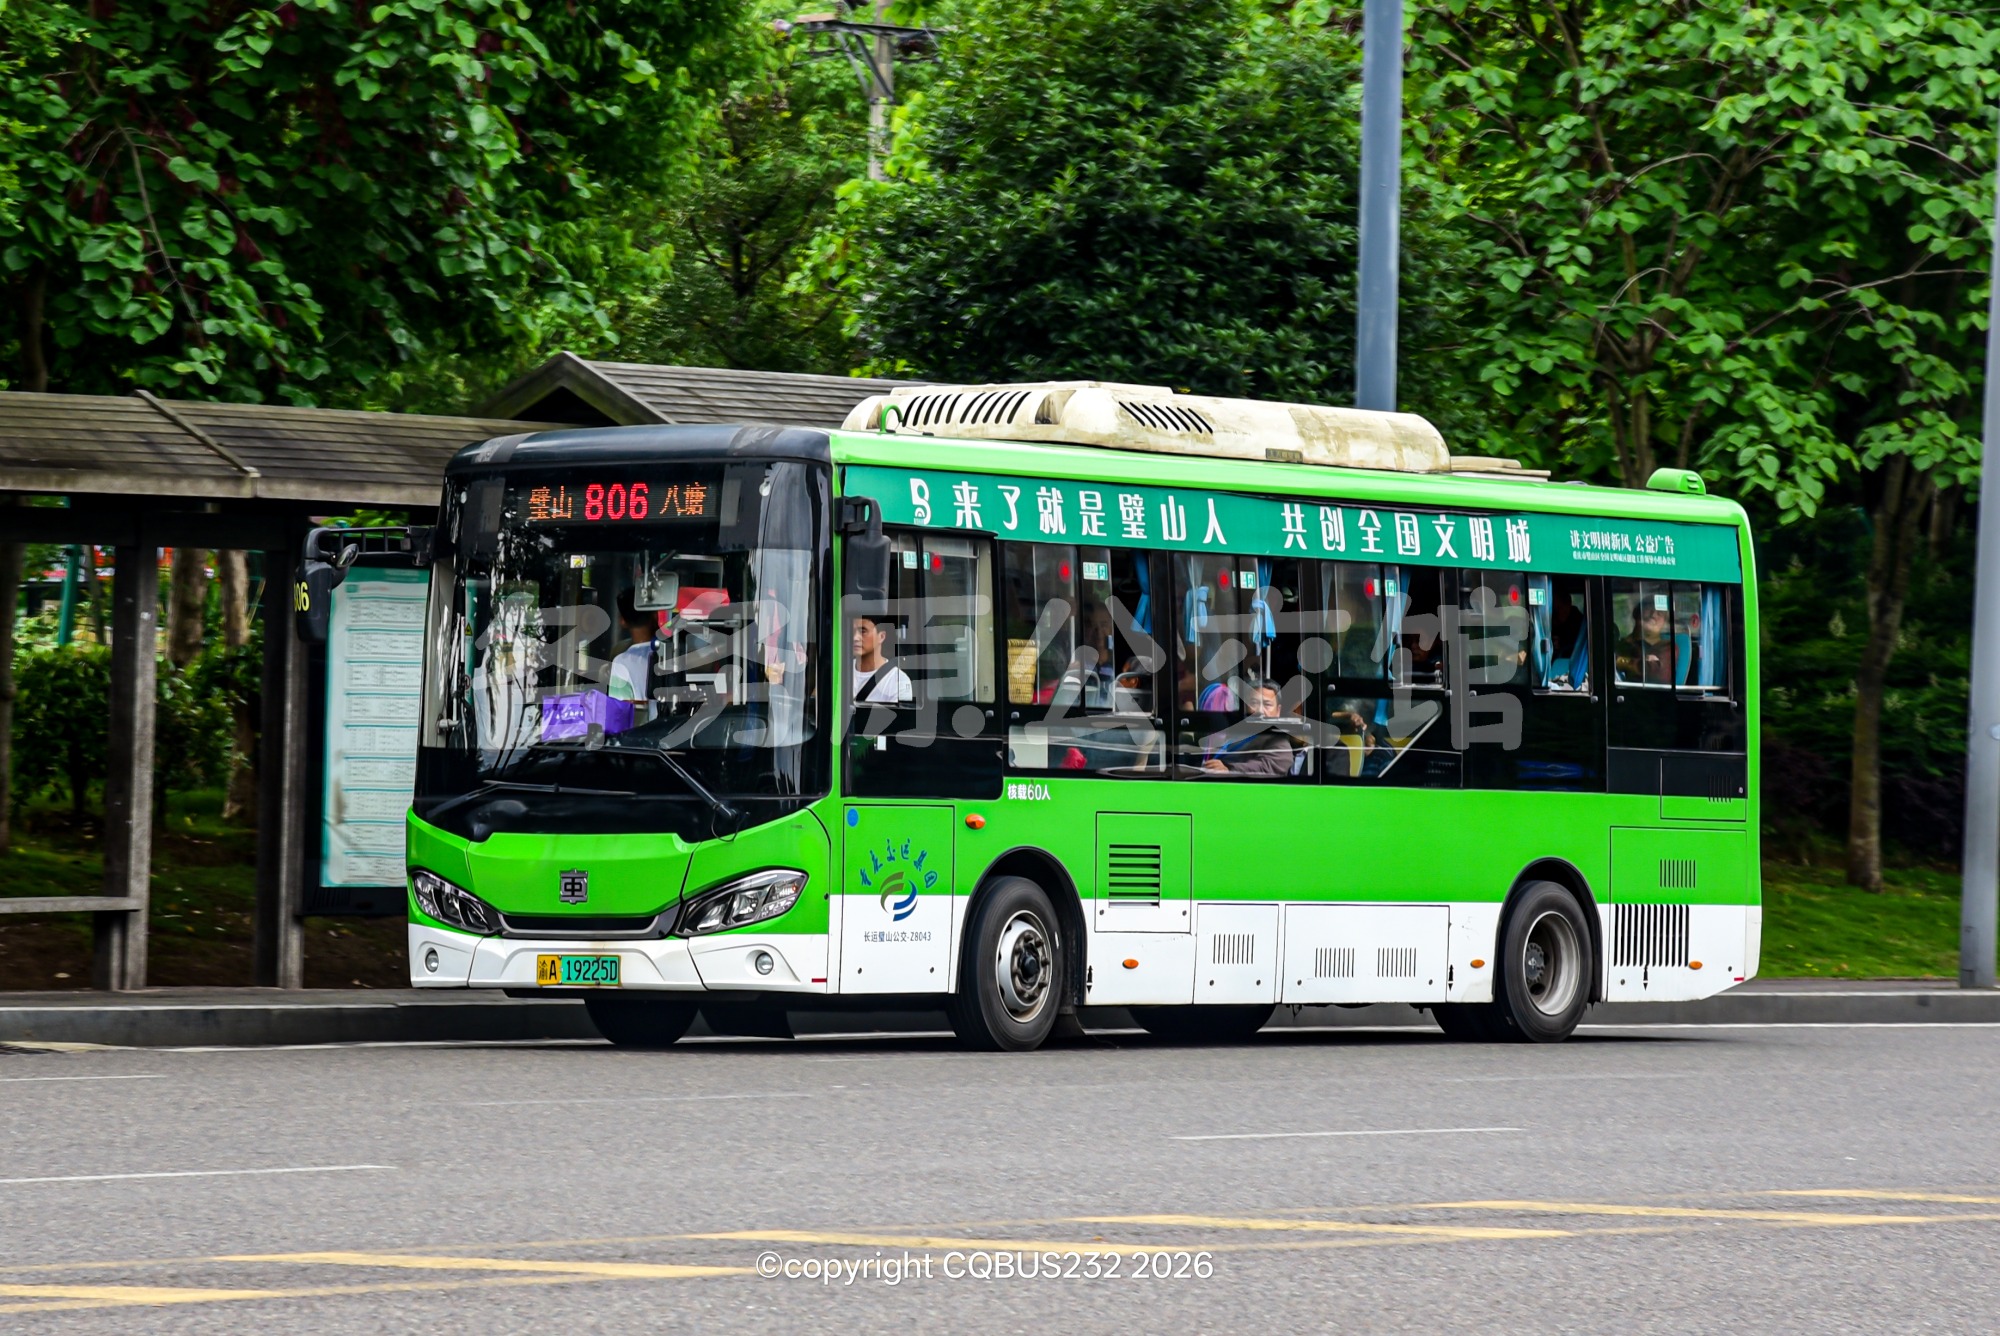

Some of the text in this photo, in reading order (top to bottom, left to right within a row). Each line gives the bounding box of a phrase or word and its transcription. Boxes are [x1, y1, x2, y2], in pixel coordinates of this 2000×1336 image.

[585, 483, 649, 520] 806
[953, 480, 1532, 565] 来了就是璧山人 共创全国文明城
[1570, 530, 1674, 555] 讲文明树新风 公益广告
[293, 582, 309, 611] 06
[1008, 784, 1051, 801] 核载60人
